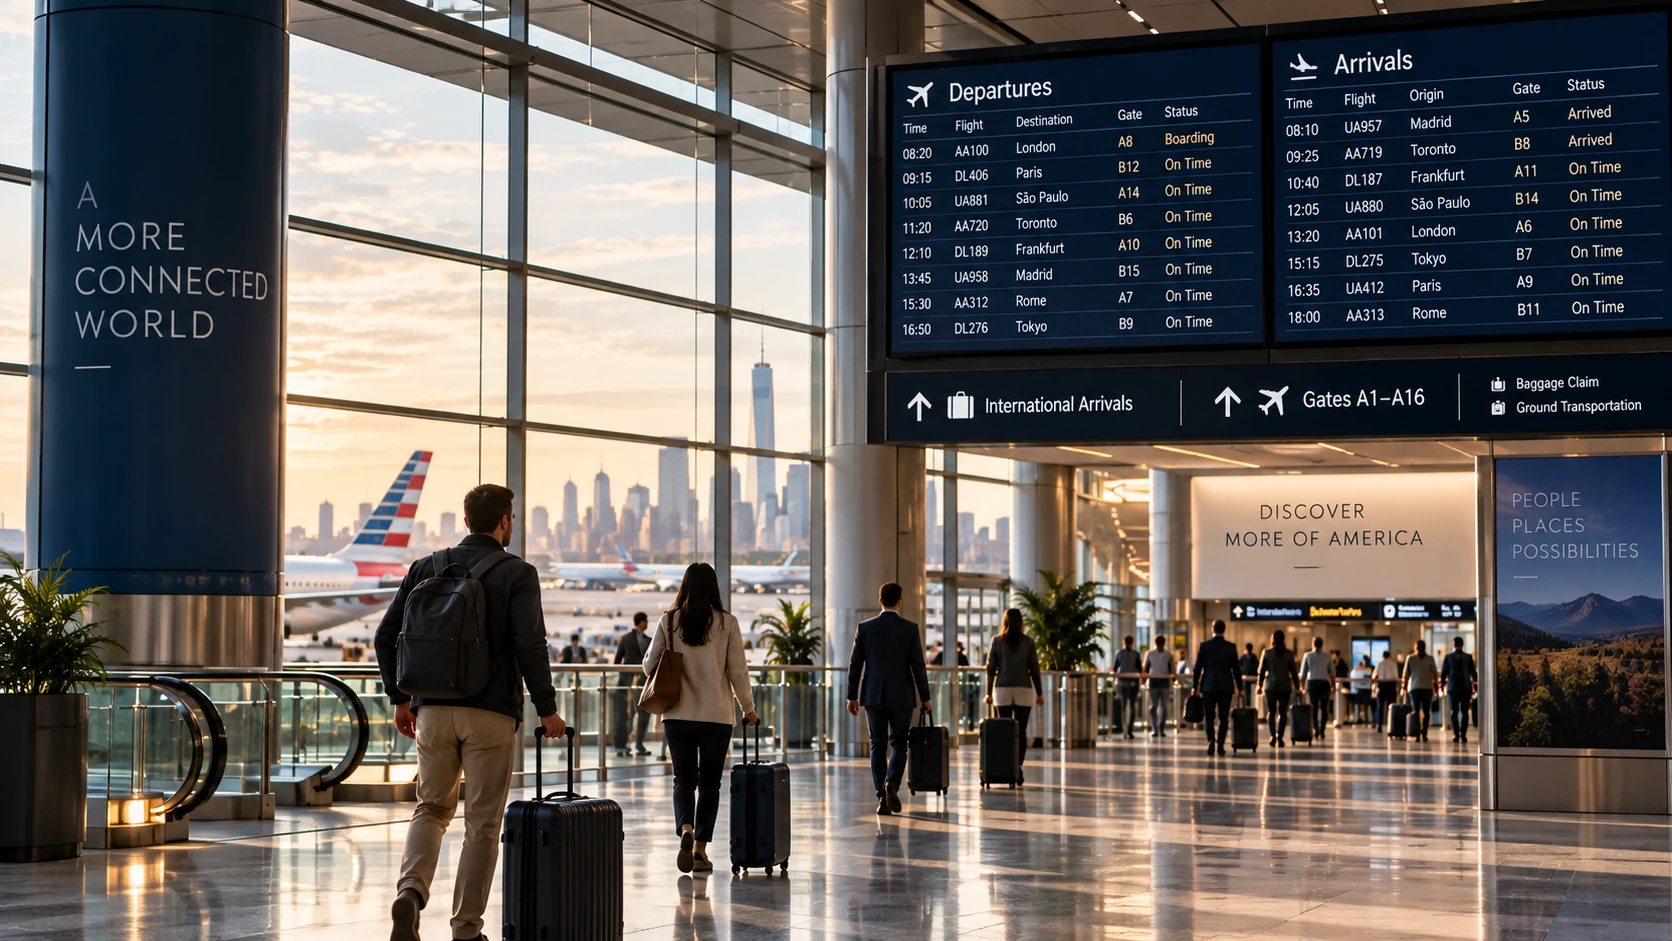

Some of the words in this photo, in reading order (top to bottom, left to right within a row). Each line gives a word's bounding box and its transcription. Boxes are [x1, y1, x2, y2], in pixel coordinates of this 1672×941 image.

[1334, 48, 1413, 75] Arrivals
[949, 80, 1053, 106] Departures
[1285, 97, 1313, 110] Time
[1344, 92, 1377, 108] Flight
[1409, 87, 1444, 104] Origin
[1512, 82, 1541, 95] Gate
[1567, 78, 1605, 92] Status
[902, 122, 928, 135] Time
[955, 118, 984, 134] Flight
[1016, 113, 1073, 128] Destination
[1117, 108, 1143, 121] Gate
[1164, 105, 1199, 118] Status
[1285, 123, 1319, 137] 08:10
[1344, 119, 1383, 134] UA957
[1410, 114, 1452, 130] Madrid
[1513, 109, 1530, 123] A5
[1567, 104, 1612, 120] Arrived
[902, 146, 933, 160] 08:20
[954, 143, 989, 157] AA100
[1016, 140, 1056, 154] London
[1117, 135, 1133, 148] A8
[1165, 131, 1215, 146] Boarding
[1286, 149, 1319, 164] 09:25
[1344, 145, 1383, 161] AA719
[1410, 142, 1457, 157] Toronto
[1514, 136, 1531, 151] B8
[1568, 132, 1613, 148] Arrived
[902, 171, 932, 185] 09:15
[955, 168, 989, 182] DL406
[1016, 165, 1043, 179] Paris
[1118, 160, 1140, 173] B12
[1164, 157, 1181, 171] On
[1184, 157, 1212, 170] Time
[1287, 175, 1320, 190] 10:40
[1345, 172, 1383, 187] DL187
[1411, 168, 1465, 184] Frankfurt
[1514, 164, 1537, 178] A11
[1568, 161, 1587, 175] On
[1590, 160, 1622, 174] Time
[77, 180, 98, 210] A
[903, 196, 932, 209] 10:05
[954, 193, 988, 207] UA881
[1039, 189, 1069, 204] Paulo
[1118, 186, 1140, 199] A14
[1164, 184, 1181, 197] On
[1184, 182, 1212, 196] Time
[1287, 202, 1320, 217] 12:05
[1345, 199, 1384, 214] UA880
[1411, 197, 1434, 211] São
[1437, 195, 1471, 210] Paulo
[1515, 191, 1539, 206] B14
[1569, 189, 1588, 203] On
[1590, 188, 1622, 202] Time
[903, 221, 932, 234] 11:20
[954, 219, 989, 232] AA720
[1015, 217, 1058, 230] Toronto
[1118, 212, 1134, 226] B6
[1164, 210, 1181, 223] On
[1184, 209, 1213, 222] Time
[1287, 229, 1320, 243] 13:20
[1345, 226, 1382, 241] AA101
[1411, 223, 1456, 238] London
[1515, 219, 1533, 233] A6
[1569, 217, 1588, 231] On
[1591, 216, 1623, 230] Time
[76, 221, 185, 253] MORE
[902, 246, 932, 260] 12:10
[954, 244, 989, 258] DL189
[1016, 241, 1065, 256] Frankfurt
[1118, 238, 1140, 251] A10
[1165, 236, 1182, 250] On
[1184, 235, 1213, 249] Time
[1288, 256, 1320, 270] 15:15
[1345, 253, 1384, 268] DL275
[1411, 251, 1447, 268] Tokyo
[1516, 247, 1533, 261] B7
[1570, 245, 1589, 259] On
[1591, 244, 1624, 258] Time
[75, 265, 268, 301] CONNECTED
[902, 271, 932, 285] 13:45
[954, 270, 989, 284] UA958
[1015, 267, 1053, 281] Madrid
[1118, 264, 1140, 278] B15
[1165, 263, 1182, 276] On
[1184, 262, 1213, 275] Time
[1288, 283, 1321, 297] 16:35
[1346, 280, 1384, 295] UA412
[1412, 278, 1442, 293] Paris
[1516, 275, 1534, 289] A9
[1571, 273, 1589, 287] On
[1592, 272, 1624, 286] Time
[902, 297, 932, 310] 15:30
[954, 295, 989, 309] AA312
[1016, 294, 1047, 307] Rome
[1118, 290, 1134, 304] A7
[1165, 289, 1182, 302] On
[1184, 288, 1213, 302] Time
[1288, 310, 1321, 324] 18:00
[1345, 308, 1385, 322] AA313
[1412, 306, 1447, 320] Rome
[1517, 302, 1540, 316] B11
[1571, 300, 1590, 315] On
[1593, 299, 1625, 314] Time
[74, 309, 214, 339] WORLD
[902, 322, 932, 336] 16:50
[954, 321, 989, 335] DL276
[1015, 320, 1048, 336] Tokyo
[1119, 317, 1134, 330] B9
[1165, 315, 1182, 329] On
[1184, 315, 1213, 328] Time
[1516, 376, 1565, 392] Baggage
[1567, 375, 1600, 390] Claim
[985, 395, 1074, 414] International
[1078, 394, 1133, 413] Arrivals
[1302, 389, 1352, 409] Gates
[1356, 387, 1425, 408] A1–A16
[1516, 399, 1558, 415] Ground
[1560, 398, 1642, 415] Transportation
[1260, 502, 1365, 521] DISCOVER
[1512, 490, 1580, 509] PEOPLE
[1512, 516, 1585, 534] PLACES
[1225, 530, 1284, 549] MORE
[1292, 530, 1320, 548] OF
[1328, 529, 1424, 547] AMERICA
[1512, 541, 1639, 560] POSSIBILITIES
